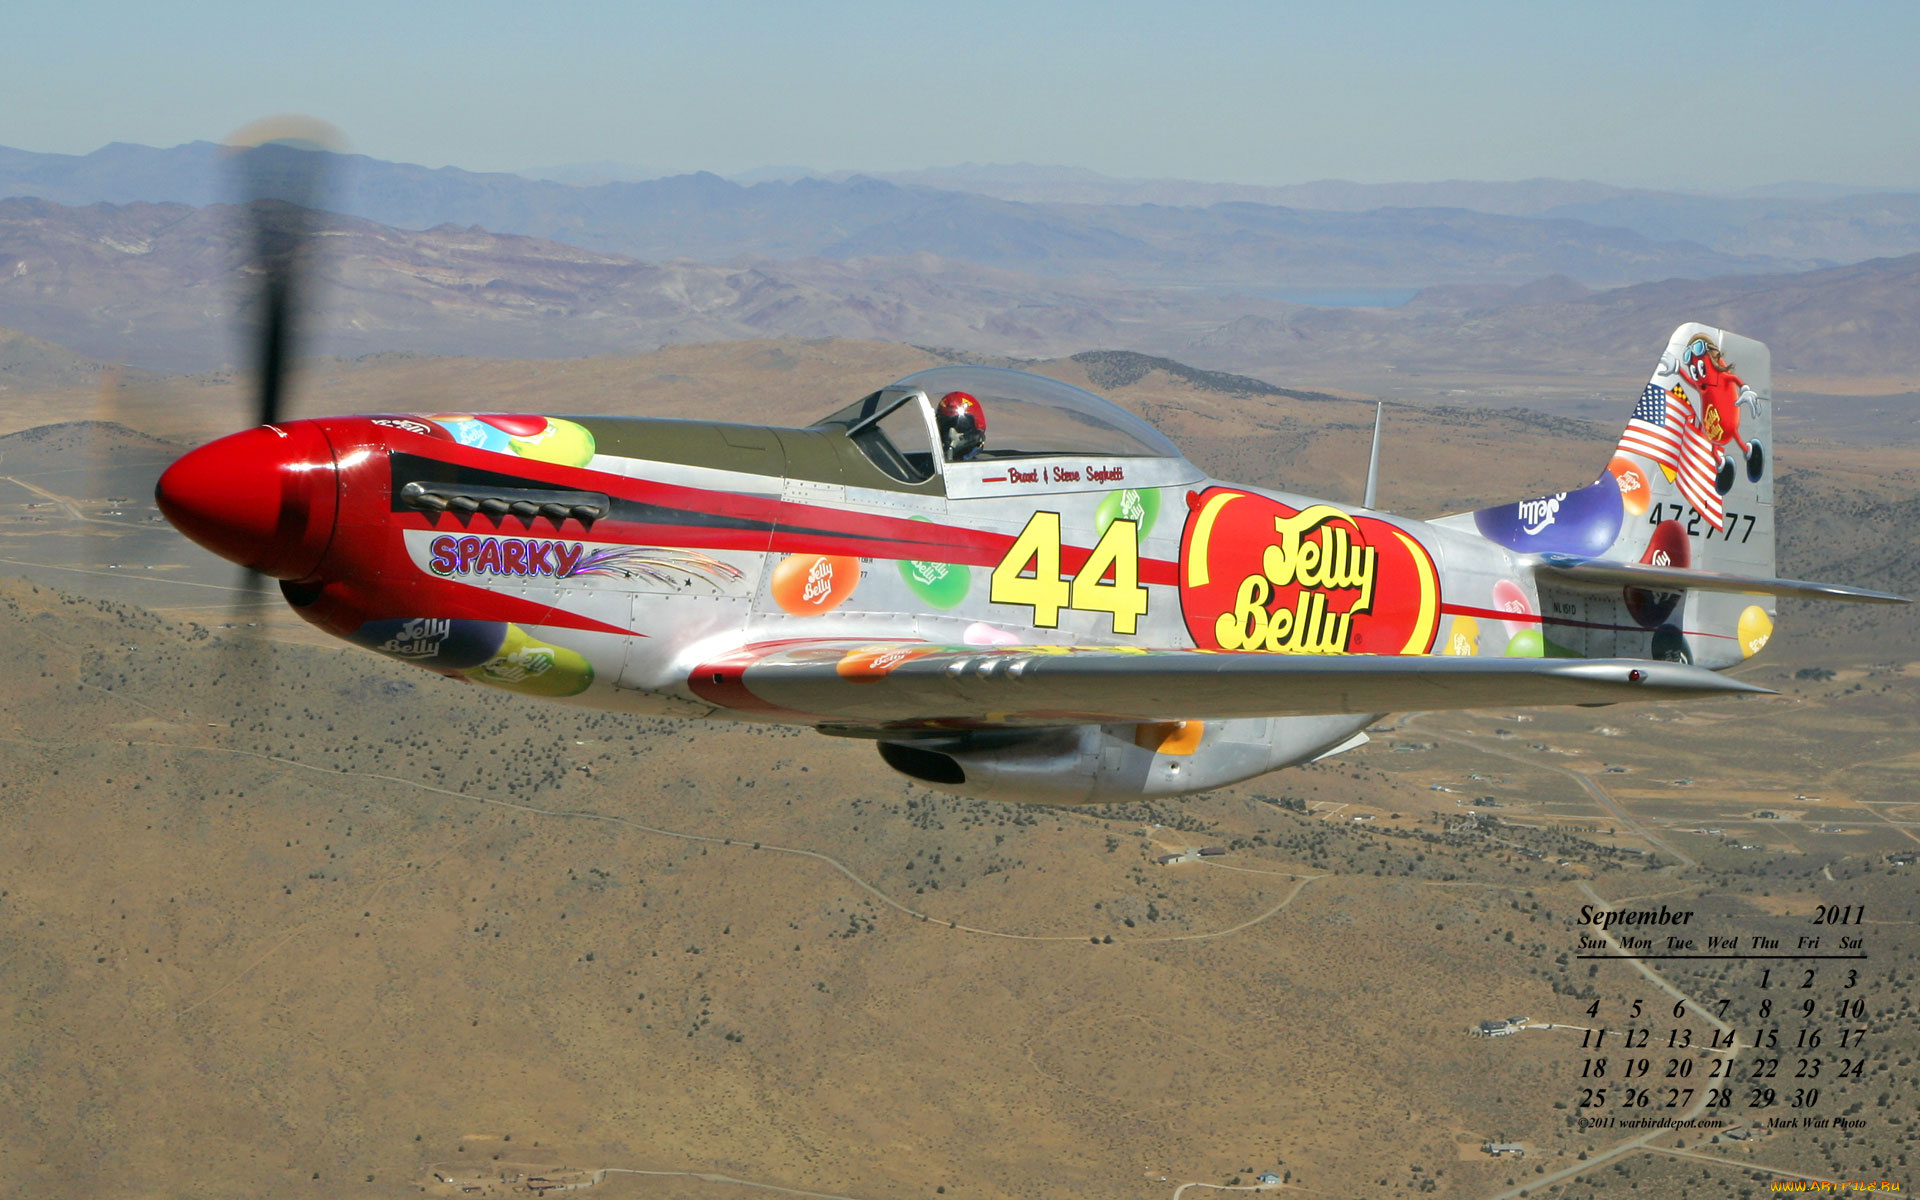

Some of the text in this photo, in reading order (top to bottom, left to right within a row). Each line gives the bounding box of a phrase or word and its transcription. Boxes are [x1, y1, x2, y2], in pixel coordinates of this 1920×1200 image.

[1053, 466, 1081, 483] Steve
[430, 535, 584, 579] SPARKY
[808, 557, 834, 584] Jelly
[1263, 504, 1378, 616] Jelly
[989, 510, 1149, 635] 44
[802, 579, 832, 604] Belly
[1215, 574, 1355, 653] Belly
[396, 618, 450, 642] Jelly
[377, 638, 440, 659] Belly
